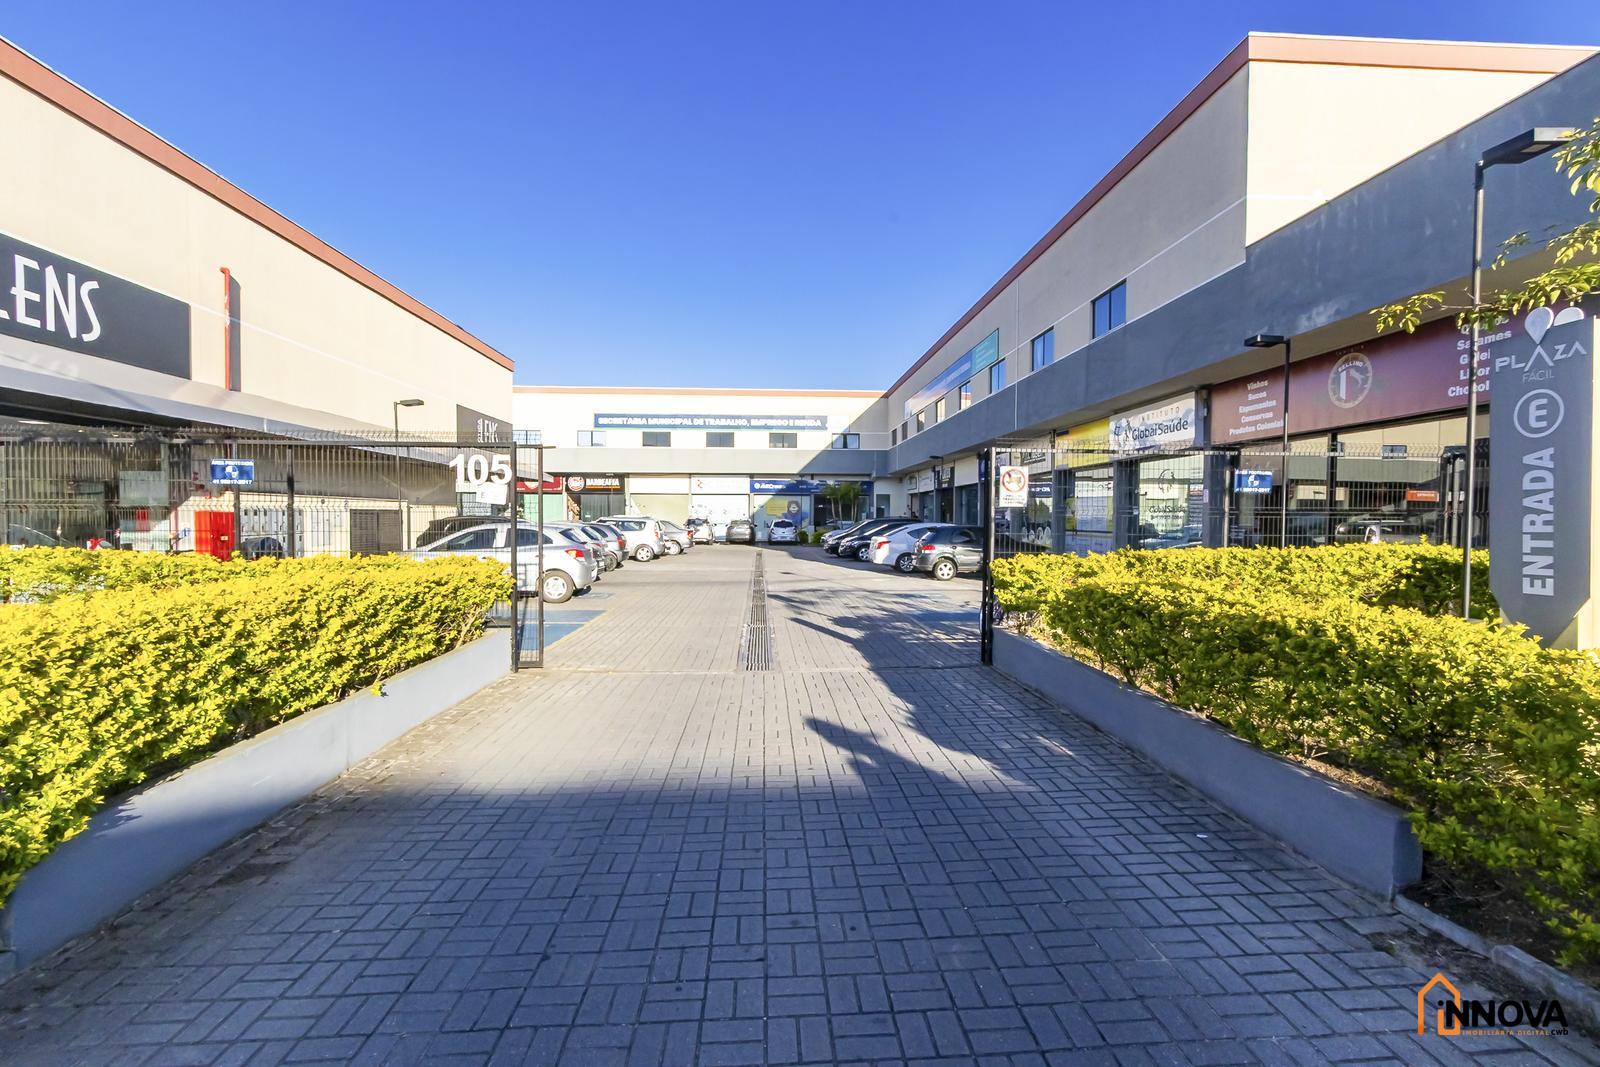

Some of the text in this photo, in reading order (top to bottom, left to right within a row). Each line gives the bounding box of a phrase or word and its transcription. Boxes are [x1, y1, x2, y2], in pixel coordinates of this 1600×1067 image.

[0, 254, 101, 342] ENS
[1456, 330, 1512, 350] Saames
[1495, 341, 1588, 372] PLAZA
[1131, 417, 1189, 441] GlobalSaúde
[449, 453, 513, 485] 105
[1522, 447, 1554, 596] ENTRADA
